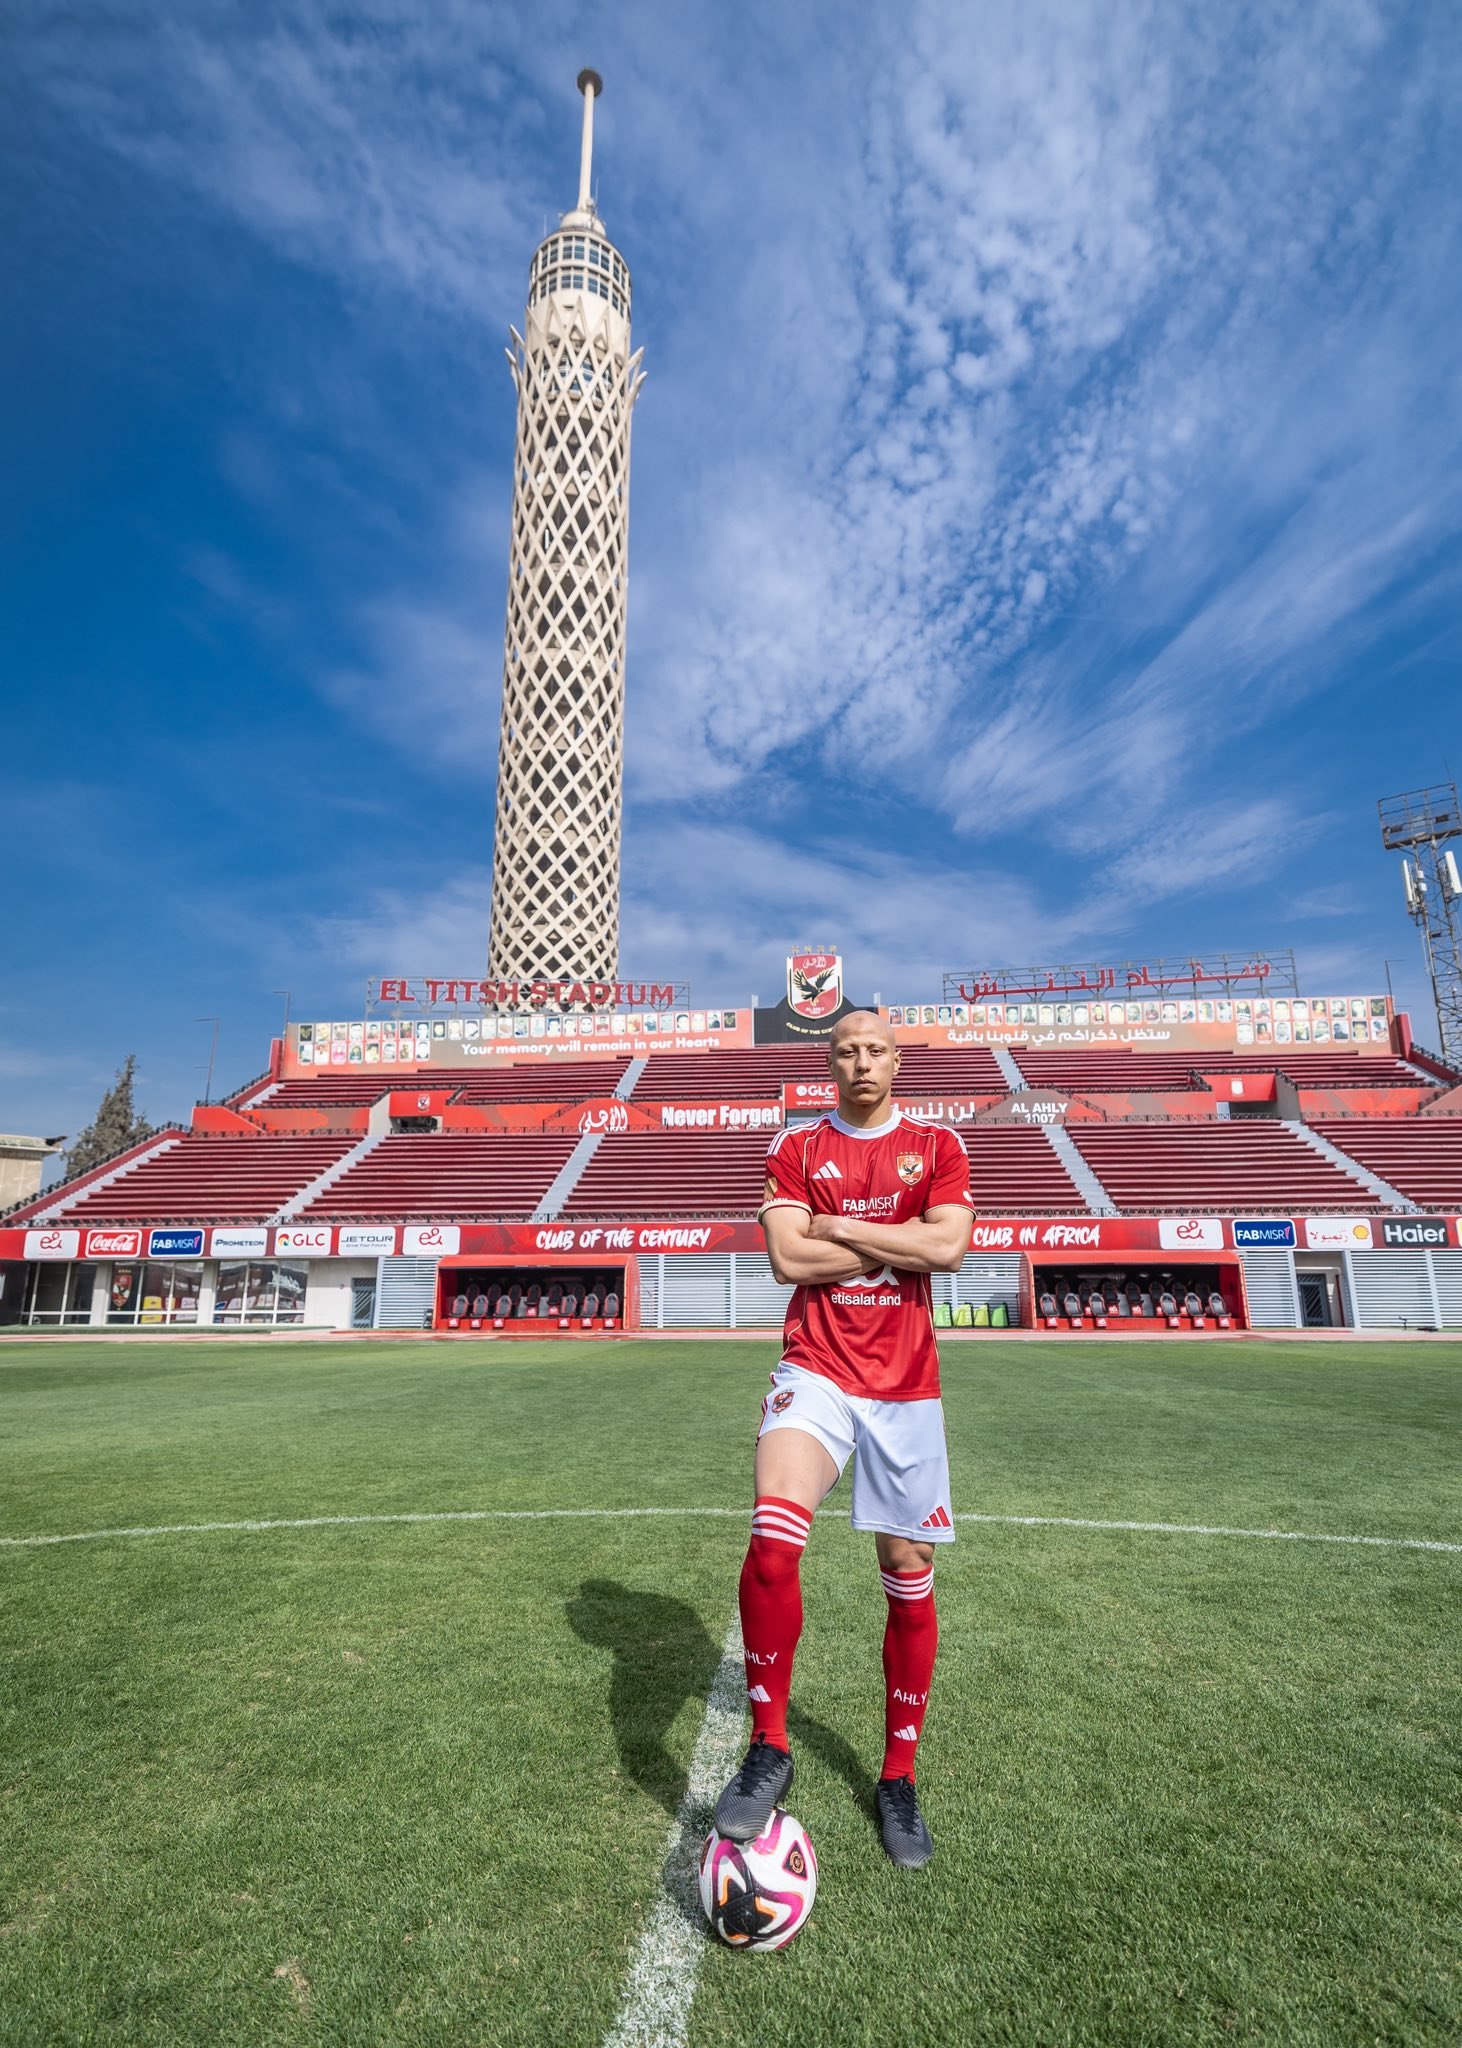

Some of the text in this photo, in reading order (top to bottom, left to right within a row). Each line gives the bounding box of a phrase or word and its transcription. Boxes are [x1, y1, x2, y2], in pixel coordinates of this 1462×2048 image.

[959, 962, 1270, 1002] ستاد التتش
[380, 980, 674, 1005] EL TITSH STADIUM
[461, 1036, 719, 1056] Your memory will remain in our Hearts
[947, 1028, 1171, 1046] ستظل ذكراكم في قلوبنا باقية
[807, 1085, 836, 1097] GLC
[662, 1105, 781, 1128] Never Forget
[948, 1102, 975, 1123] لن
[1011, 1102, 1068, 1113] AL AHLY
[292, 1233, 325, 1246] GLC
[536, 1227, 712, 1250] CLUB OF THE CENTURY
[973, 1224, 1101, 1248] CLUB IN AFRICA
[1237, 1230, 1285, 1240] FABMISR
[1385, 1225, 1446, 1243] Haier
[152, 1239, 194, 1249] FABMISR
[831, 1292, 901, 1306] etisalat and
[893, 1688, 928, 1706] AHLY
